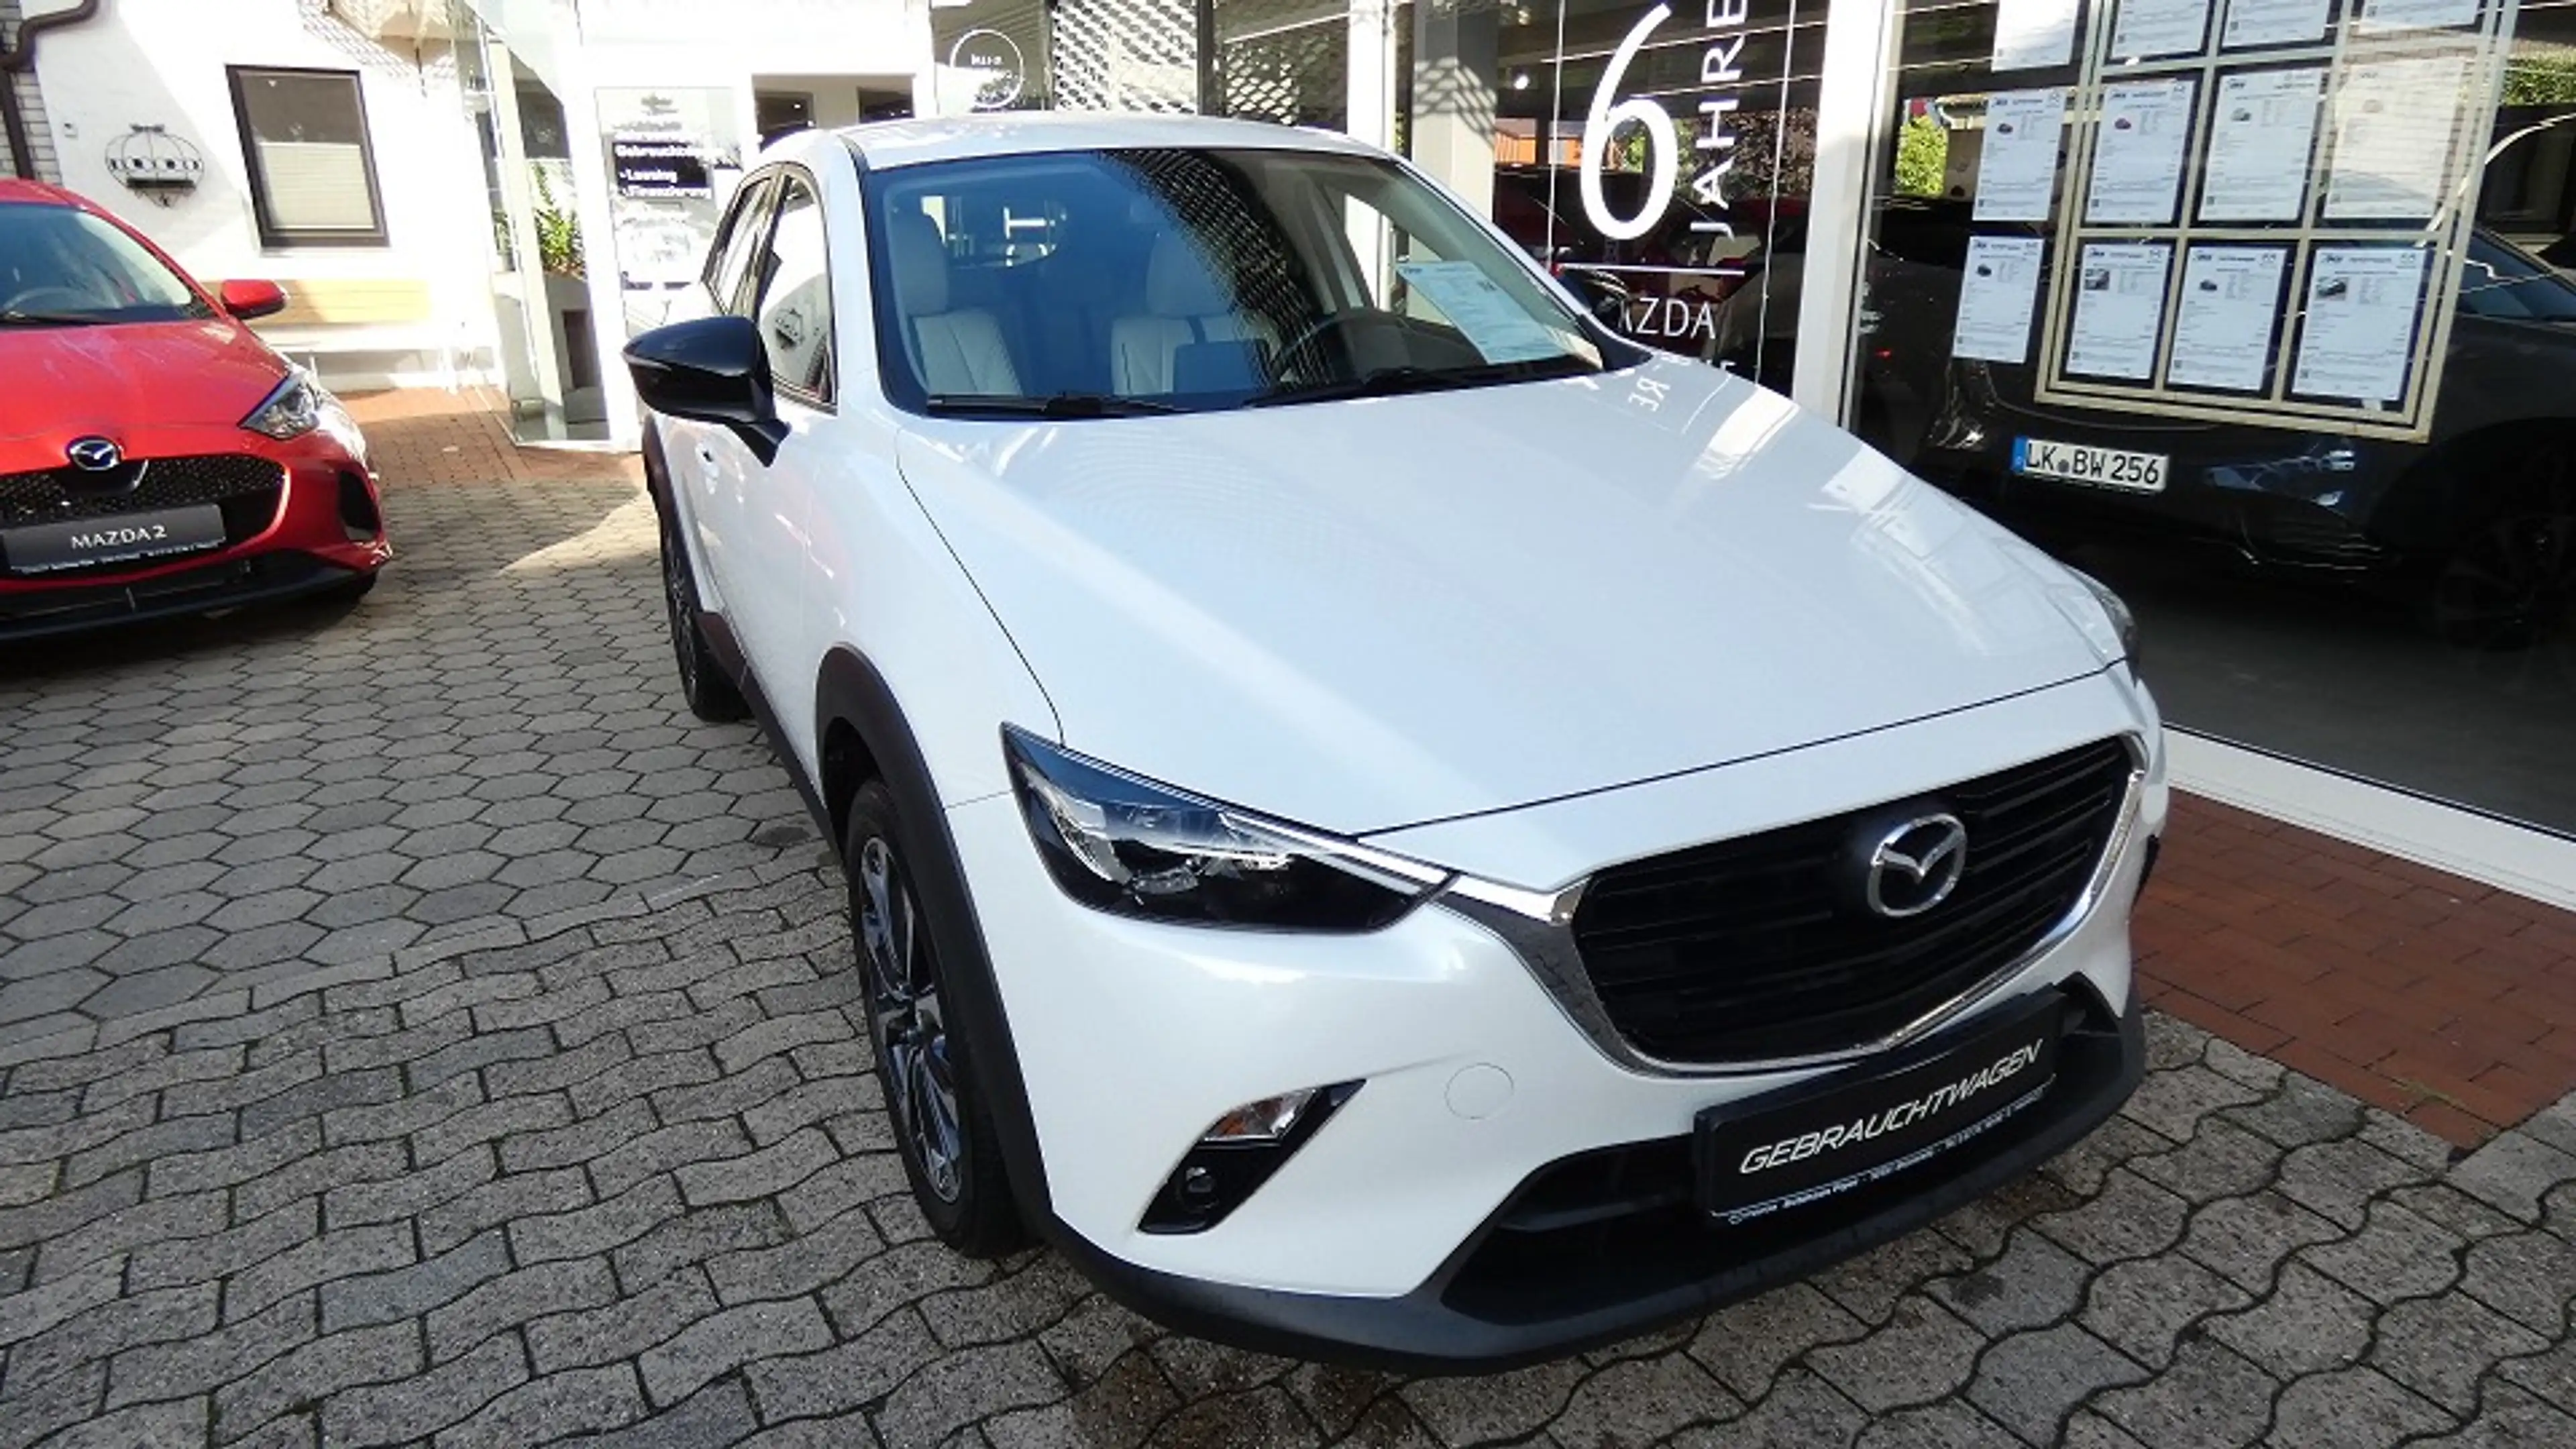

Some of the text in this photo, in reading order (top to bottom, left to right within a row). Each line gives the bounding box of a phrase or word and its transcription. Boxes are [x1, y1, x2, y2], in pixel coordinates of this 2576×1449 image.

[1580, 3, 1678, 240] 6
[1690, 0, 1747, 243] JAHRE
[2025, 443, 2058, 471] LK
[2072, 449, 2107, 478] BW
[2110, 453, 2159, 485] 256
[1739, 1038, 2044, 1175] GEBRAUCHTWAGEN
